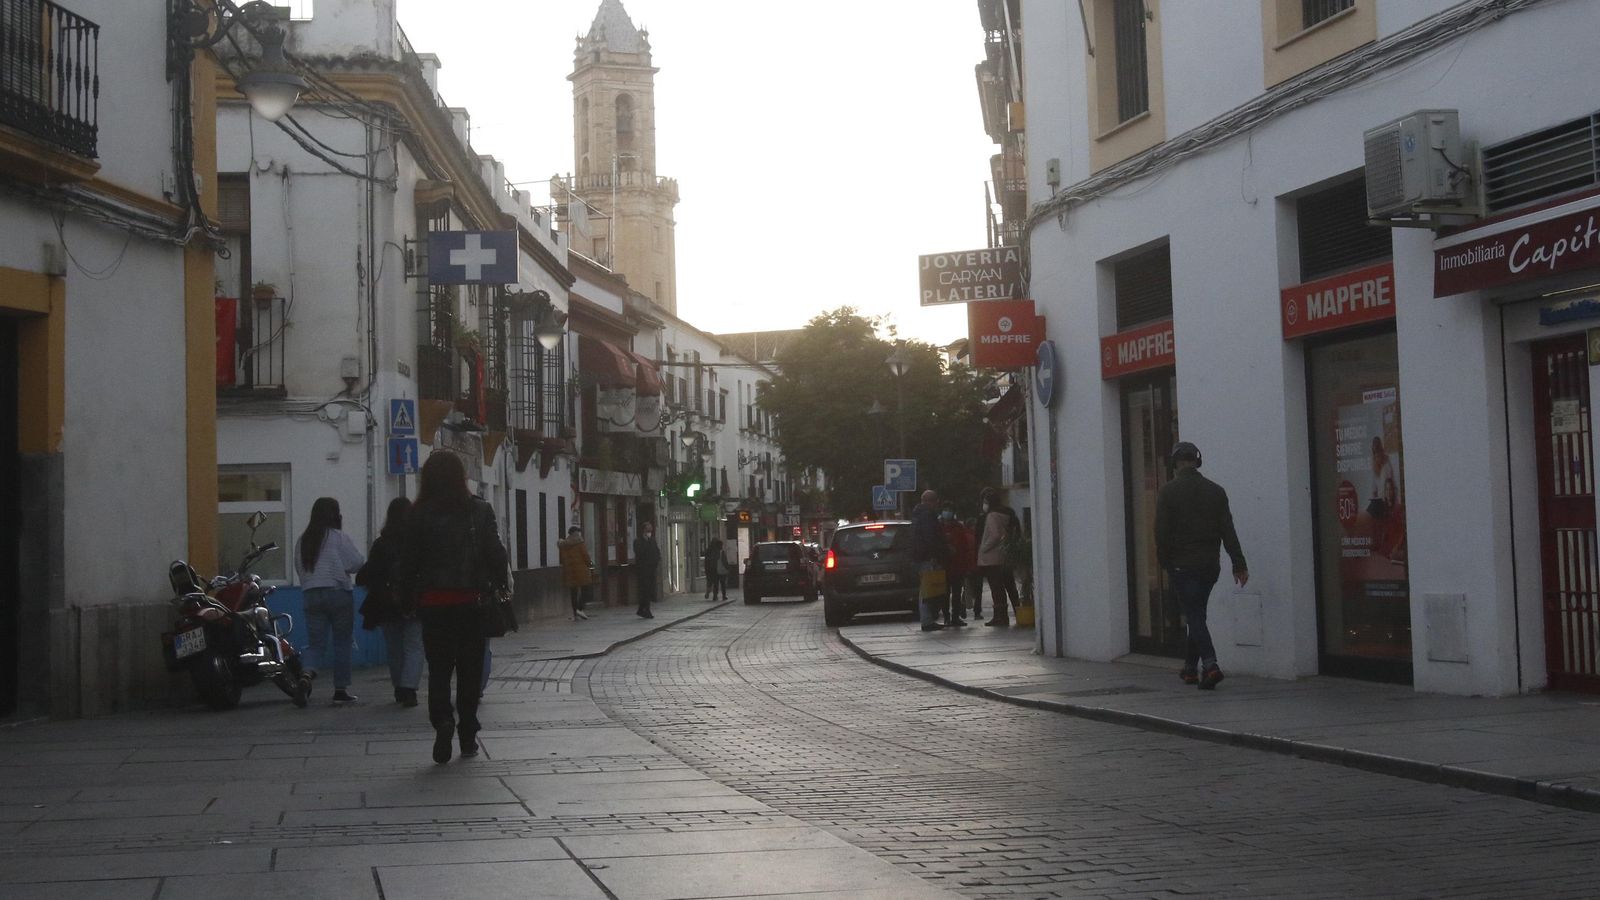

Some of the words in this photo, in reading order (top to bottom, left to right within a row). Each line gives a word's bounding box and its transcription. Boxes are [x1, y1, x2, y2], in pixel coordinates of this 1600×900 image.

[1440, 240, 1505, 271] Inmobiliaria
[1509, 215, 1600, 273] Capit
[922, 250, 1017, 270] JOYERIA
[1307, 275, 1391, 321] MAPFRE
[981, 334, 1031, 344] MAPFRE
[1118, 329, 1174, 366] MAPFRE
[886, 464, 901, 485] P
